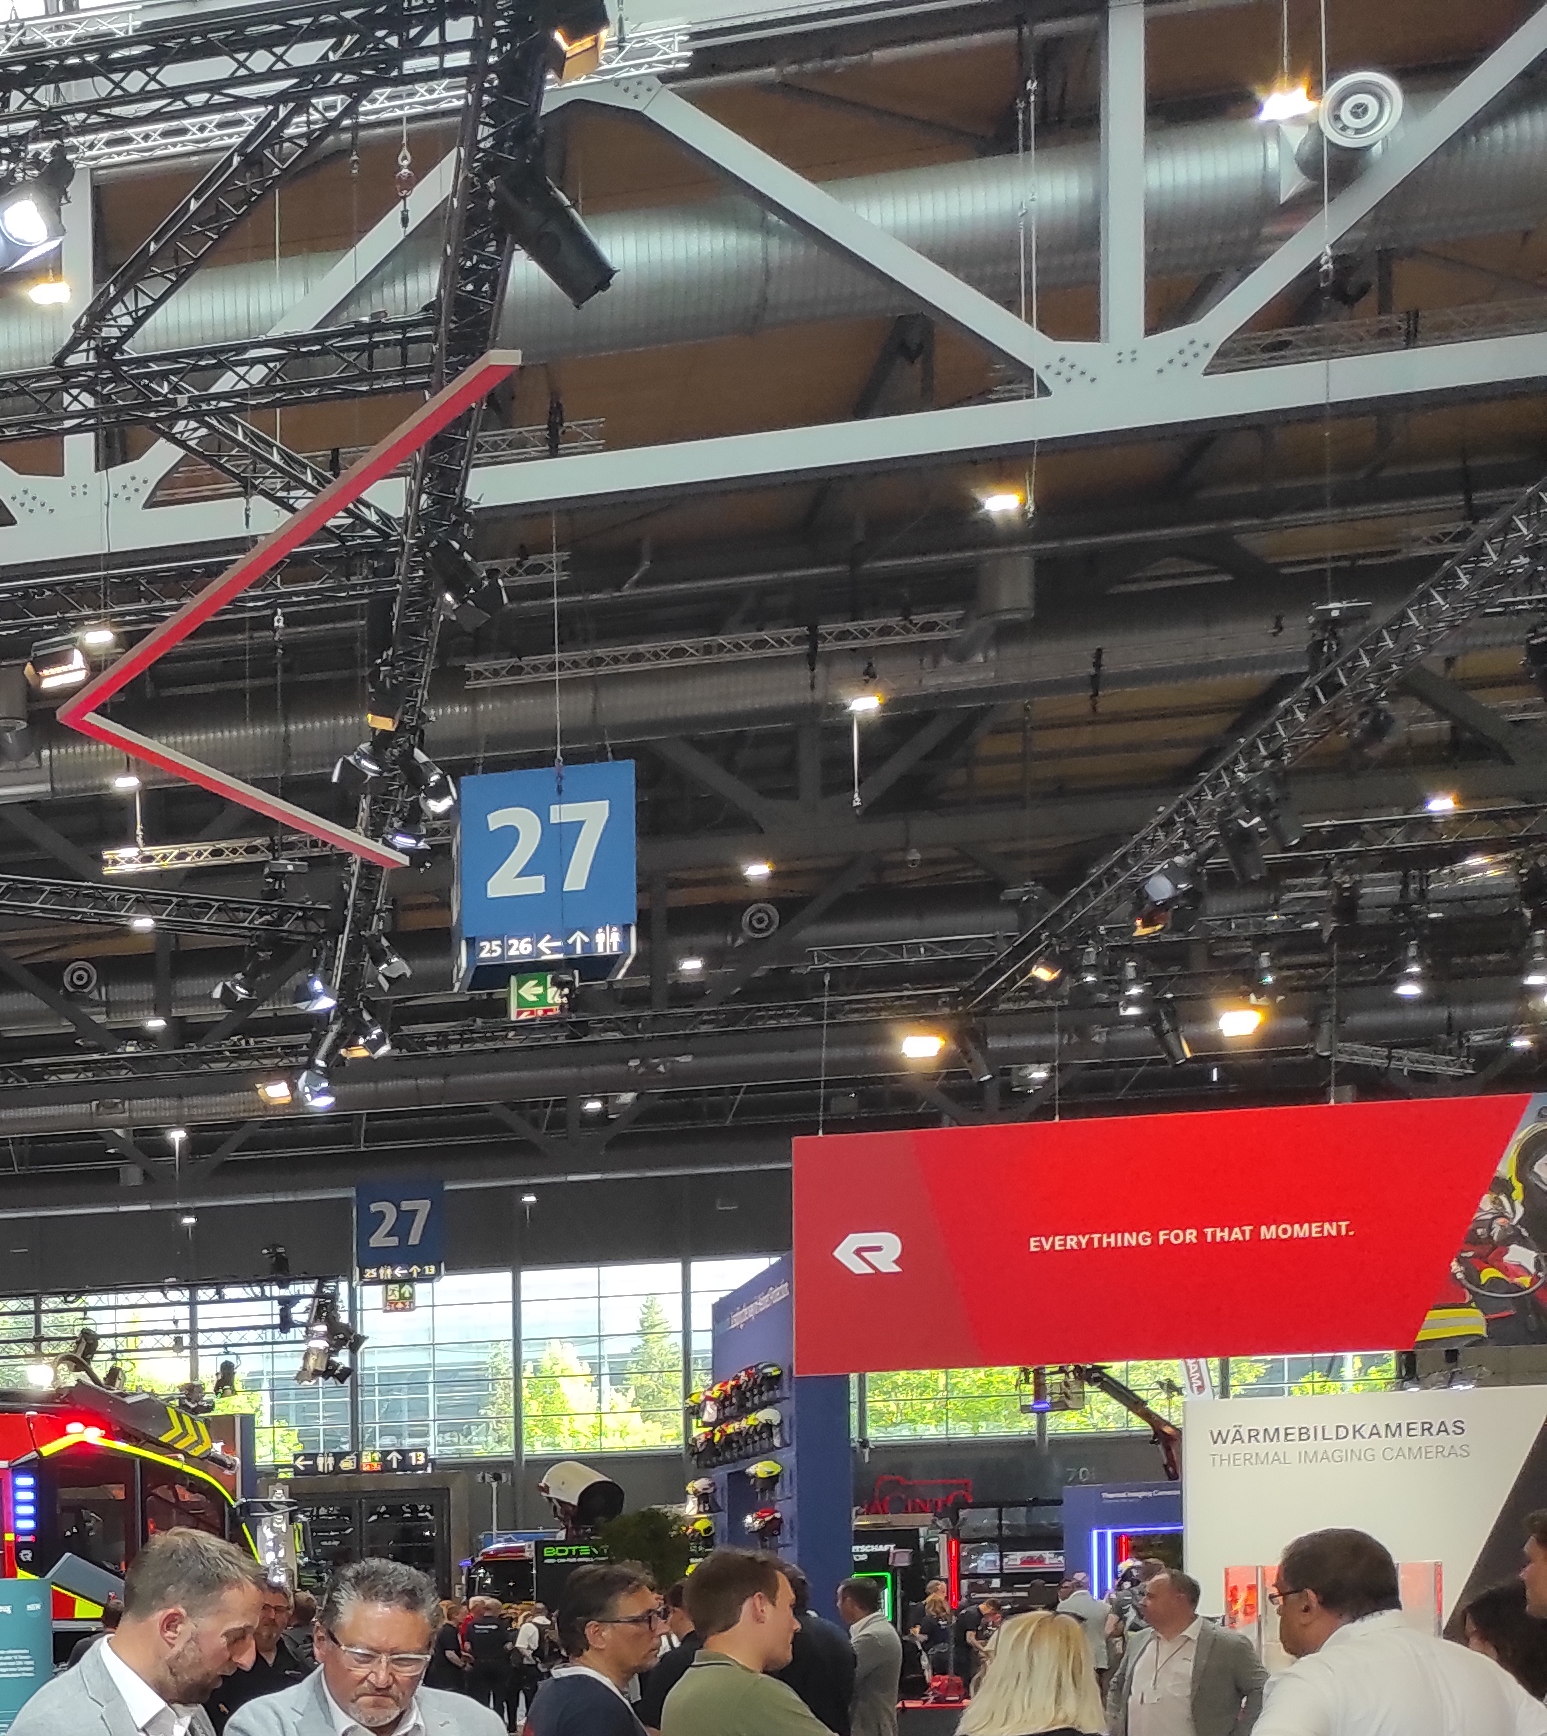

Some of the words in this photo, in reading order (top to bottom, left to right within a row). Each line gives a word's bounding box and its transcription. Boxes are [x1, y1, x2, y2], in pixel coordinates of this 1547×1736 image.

[486, 799, 610, 898] 27
[478, 939, 503, 958] 25
[507, 937, 533, 956] 26
[368, 1198, 432, 1248] 27
[1028, 1230, 1153, 1254] EVERYTHING
[1158, 1228, 1198, 1246] FOR
[1203, 1224, 1254, 1243] THAT
[1259, 1219, 1355, 1241] MOMENT.
[1209, 1418, 1467, 1446] WÄRMEBILDKAMERAS
[407, 1451, 427, 1467] 13
[1209, 1449, 1292, 1468] THERMAL
[1297, 1446, 1377, 1466] IMAGING
[1380, 1443, 1472, 1462] CAMERAS
